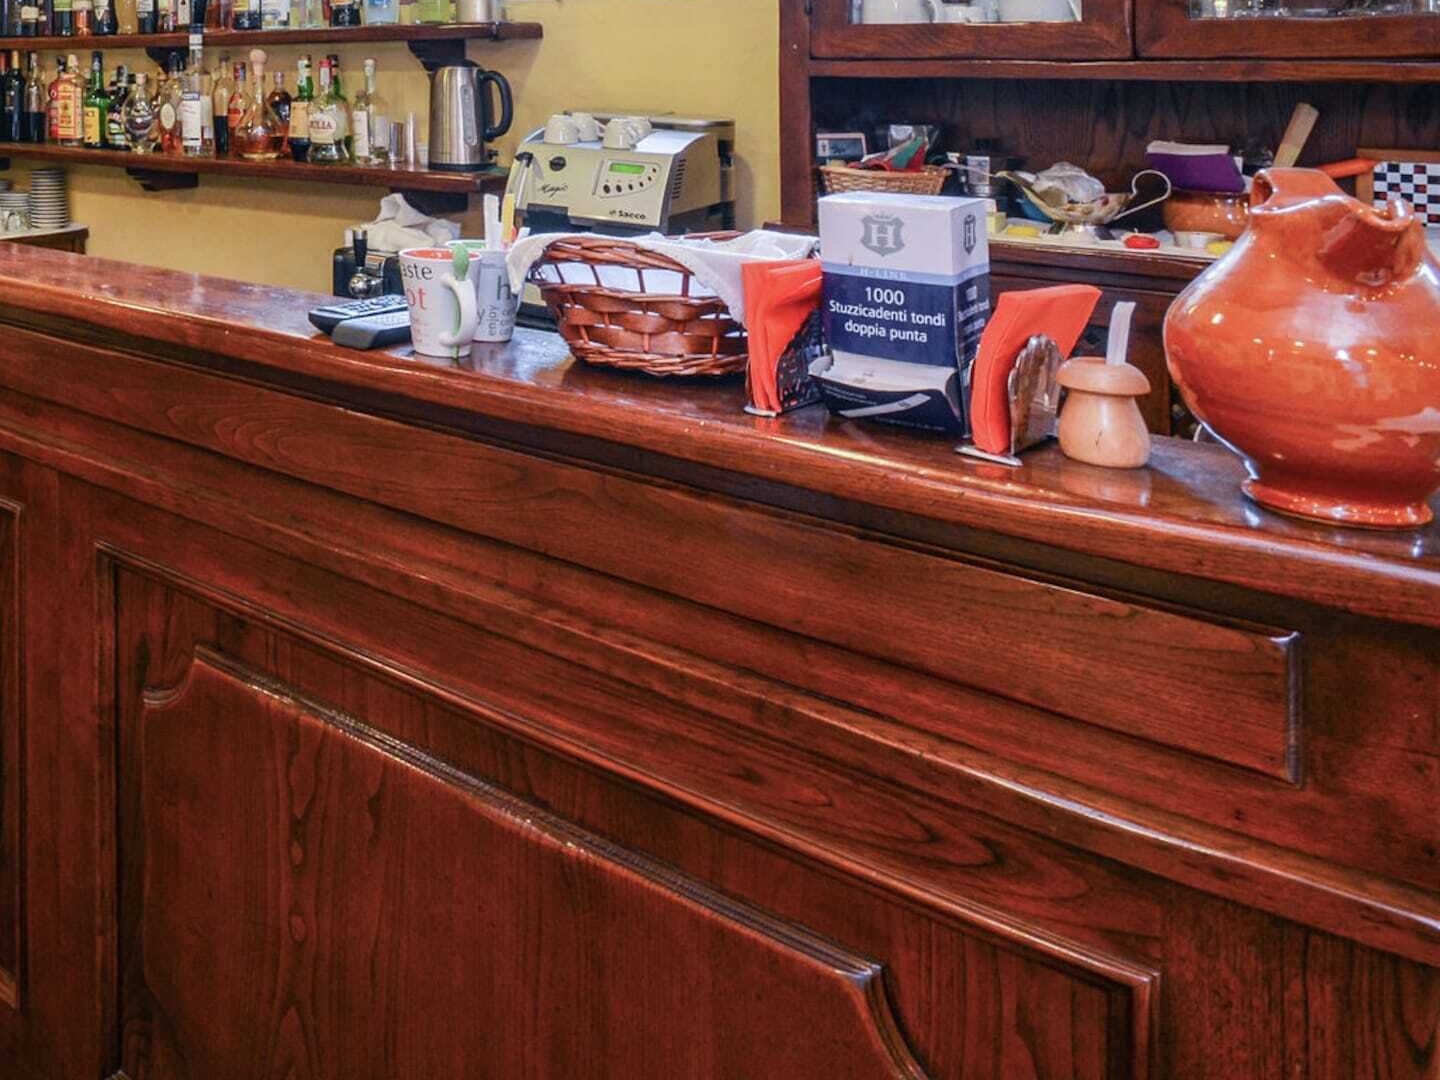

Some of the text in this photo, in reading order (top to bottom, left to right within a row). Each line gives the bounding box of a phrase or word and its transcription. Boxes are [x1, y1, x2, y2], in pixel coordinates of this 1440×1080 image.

[865, 286, 904, 306] 1000
[829, 299, 907, 322] Stuzzicadenti
[910, 310, 946, 327] tondi
[844, 320, 928, 343] doppia punta
